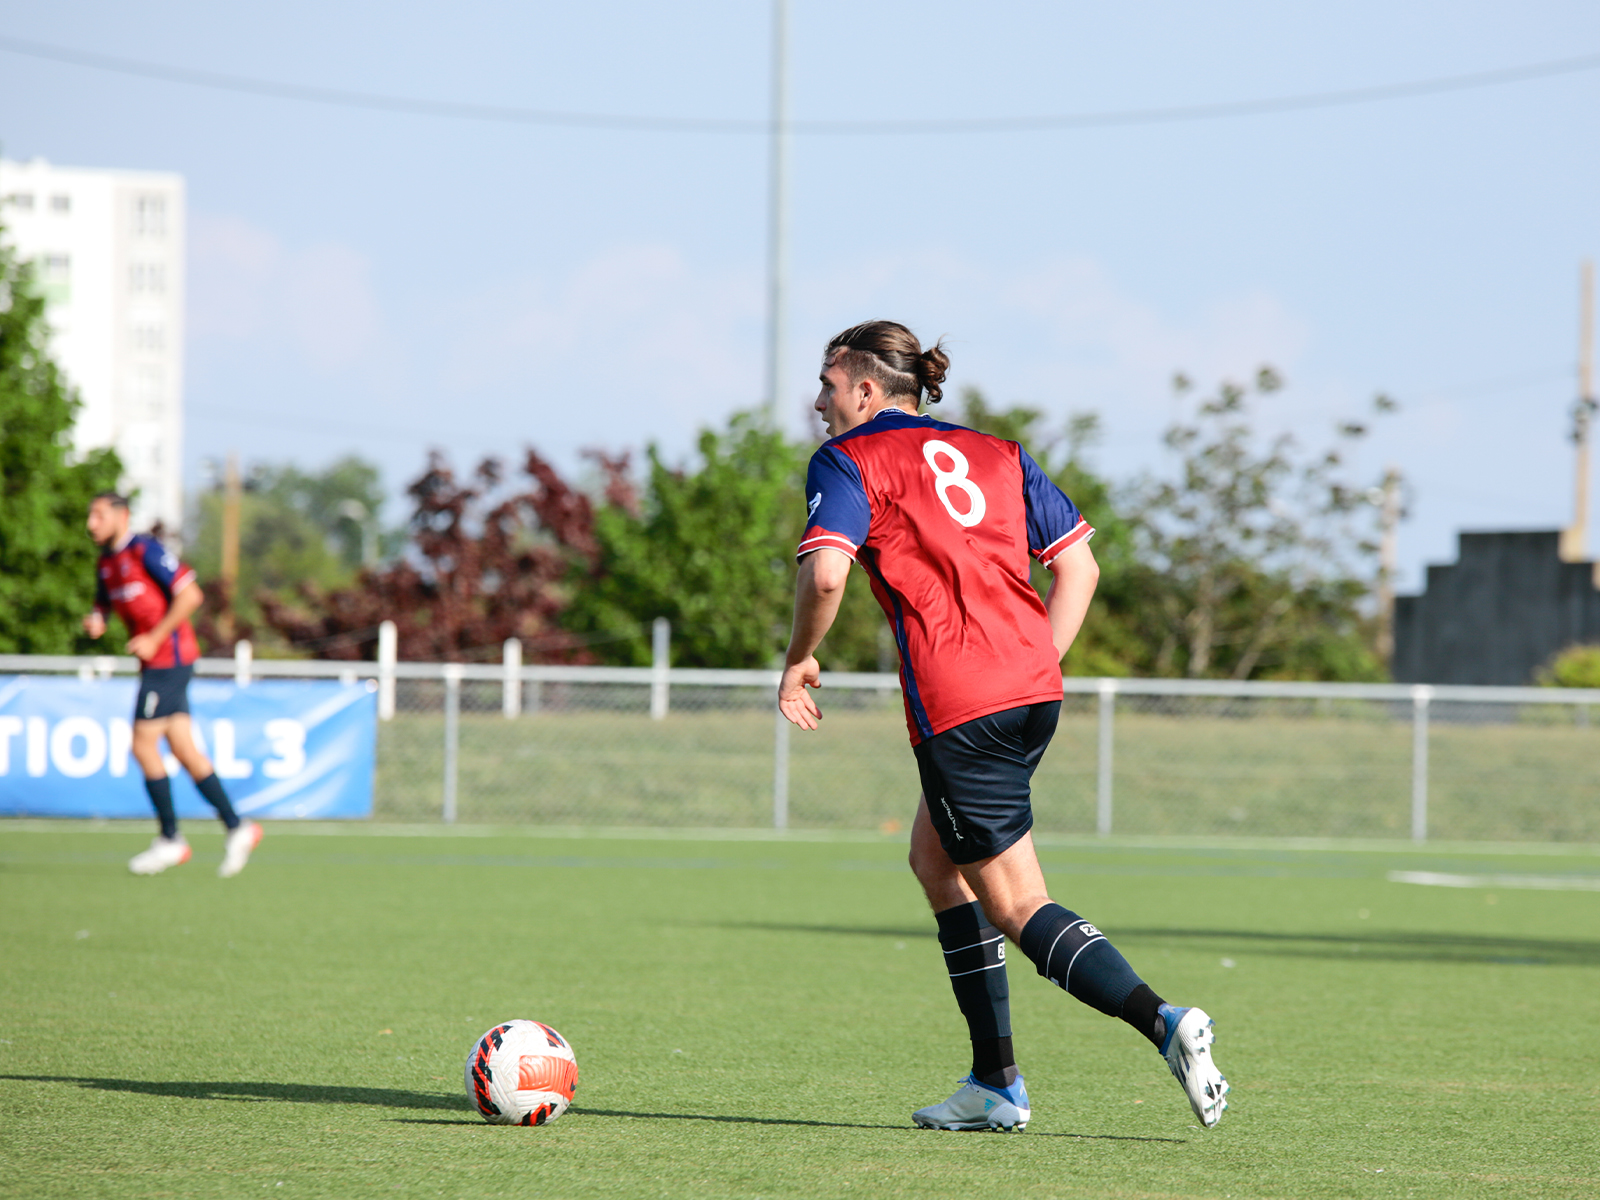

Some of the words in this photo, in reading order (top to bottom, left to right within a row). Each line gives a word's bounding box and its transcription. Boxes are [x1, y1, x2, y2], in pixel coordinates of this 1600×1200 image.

[922, 439, 986, 527] 8
[0, 715, 253, 779] TIOL
[262, 718, 307, 779] 3
